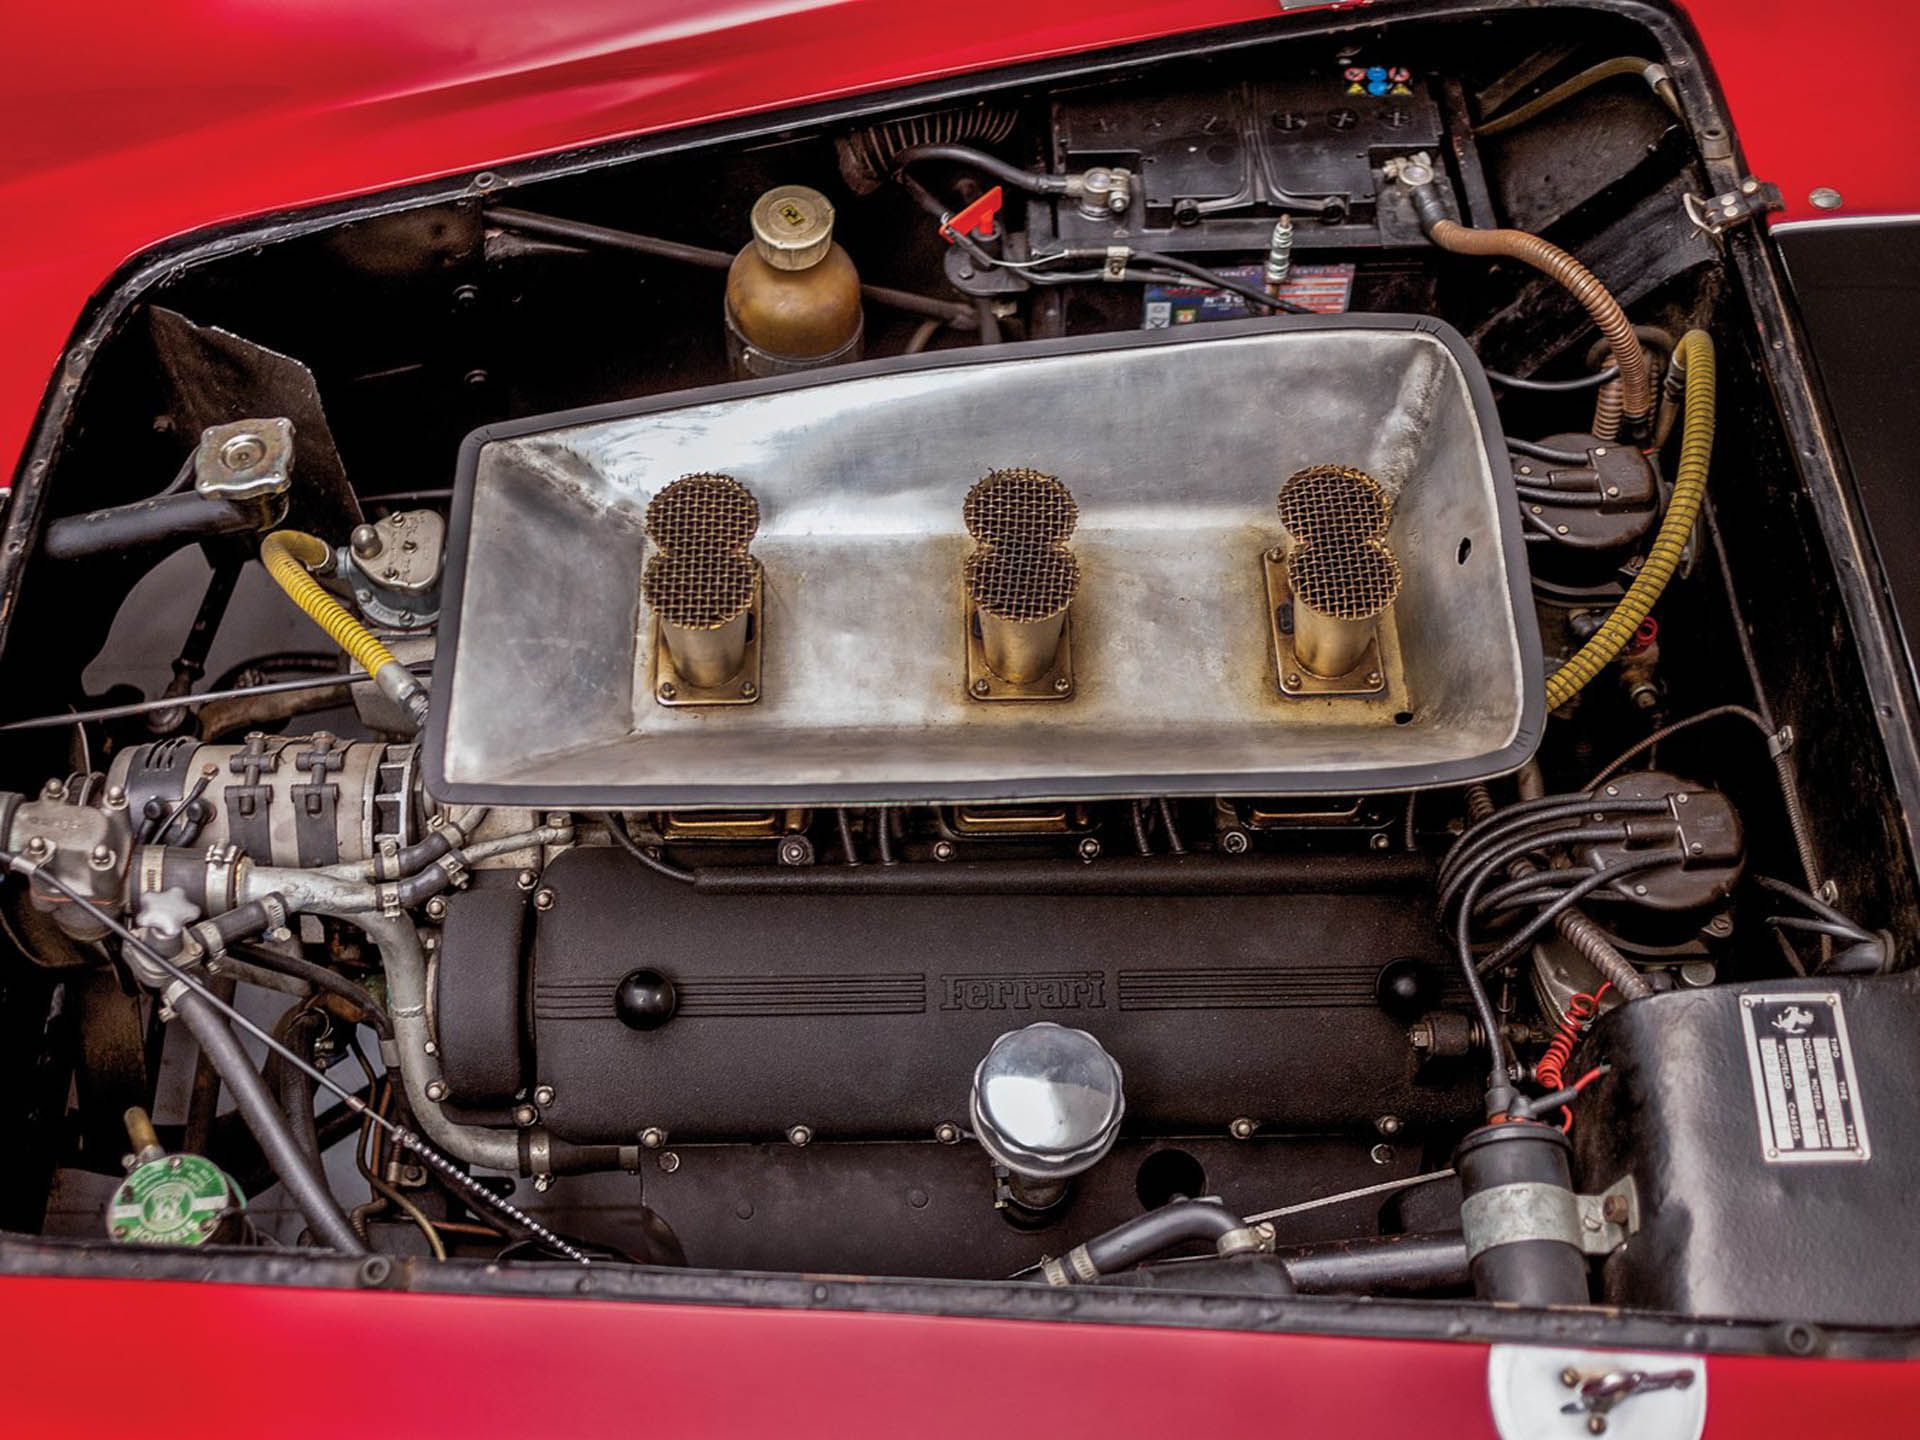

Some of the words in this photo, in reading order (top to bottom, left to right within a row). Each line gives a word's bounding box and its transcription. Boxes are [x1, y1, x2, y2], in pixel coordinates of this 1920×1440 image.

[940, 971, 1106, 1011] Ferrari
[1830, 1038, 1840, 1058] TIPO
[1803, 1038, 1815, 1069] MOTORE
[1811, 1078, 1823, 1110] MOTEUR
[1787, 1102, 1801, 1140] CHASSIS
